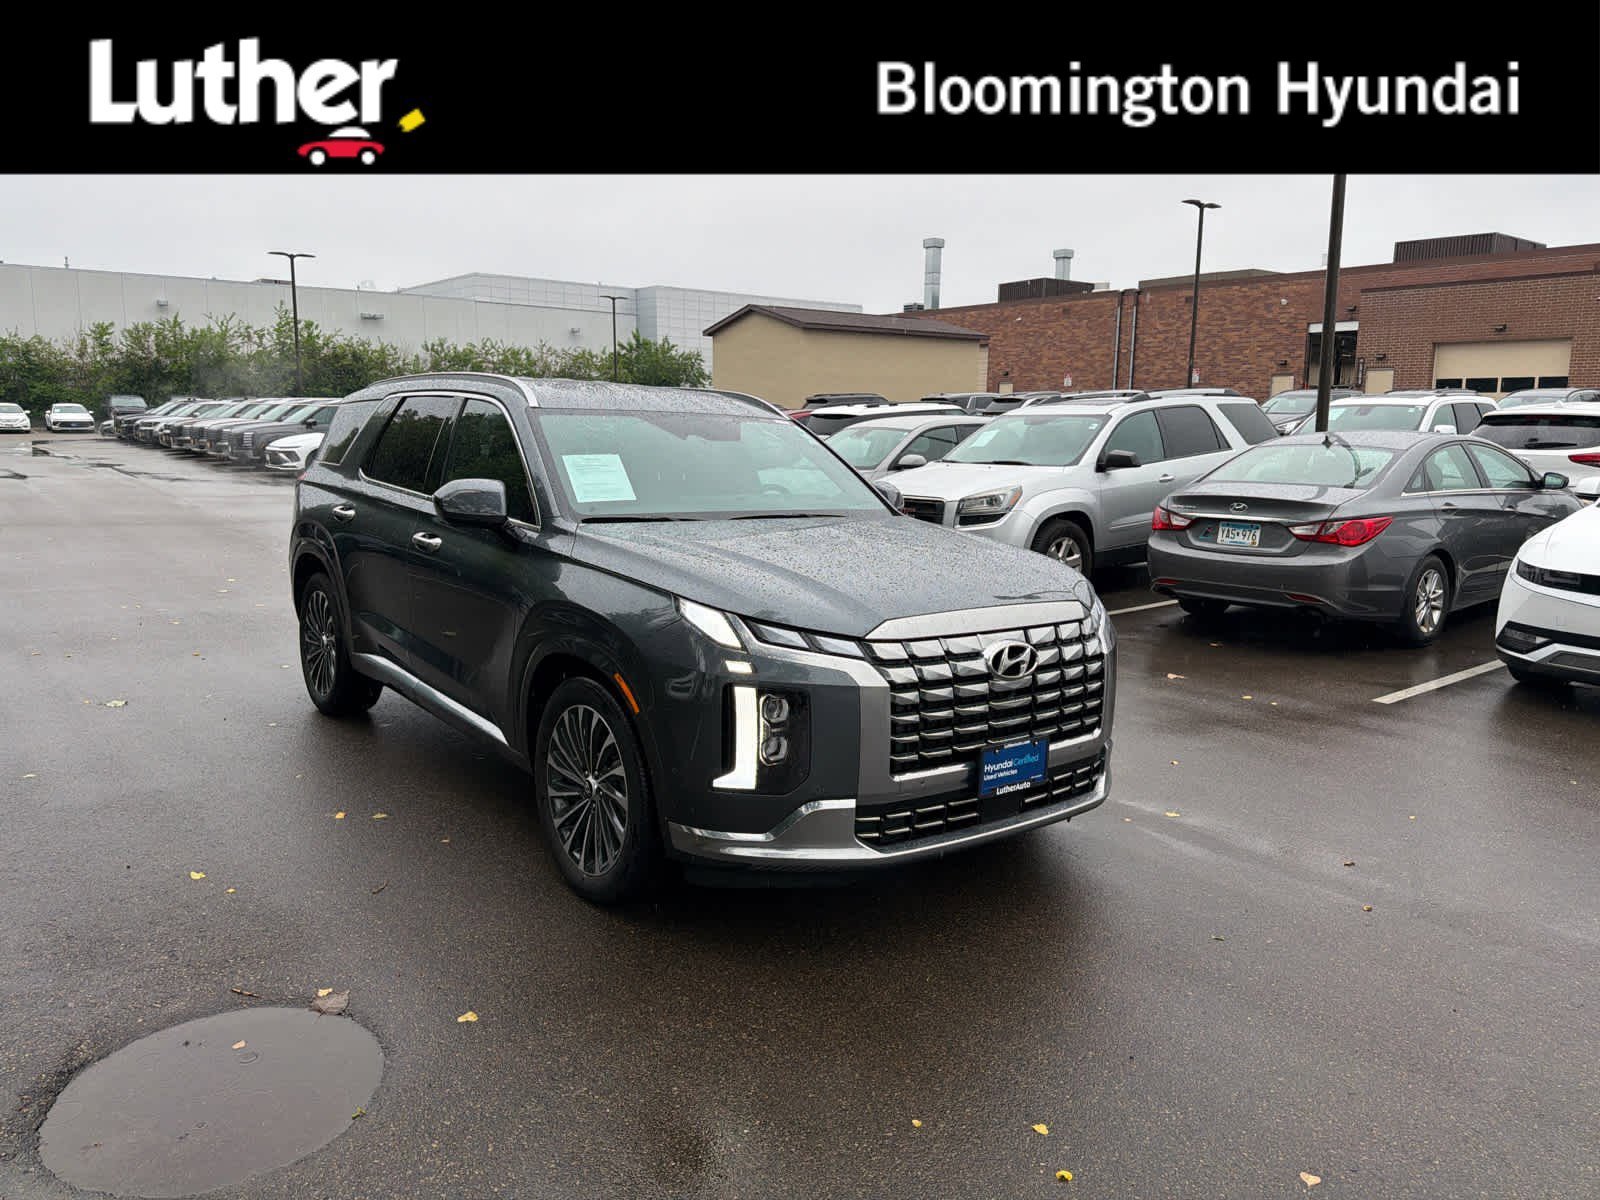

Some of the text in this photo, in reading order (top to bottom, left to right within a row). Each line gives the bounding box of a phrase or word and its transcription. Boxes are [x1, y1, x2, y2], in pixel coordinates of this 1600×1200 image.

[984, 759, 1013, 773] Hyundai
[998, 769, 1018, 777] Vehicles
[996, 781, 1031, 795] LutherAuto
